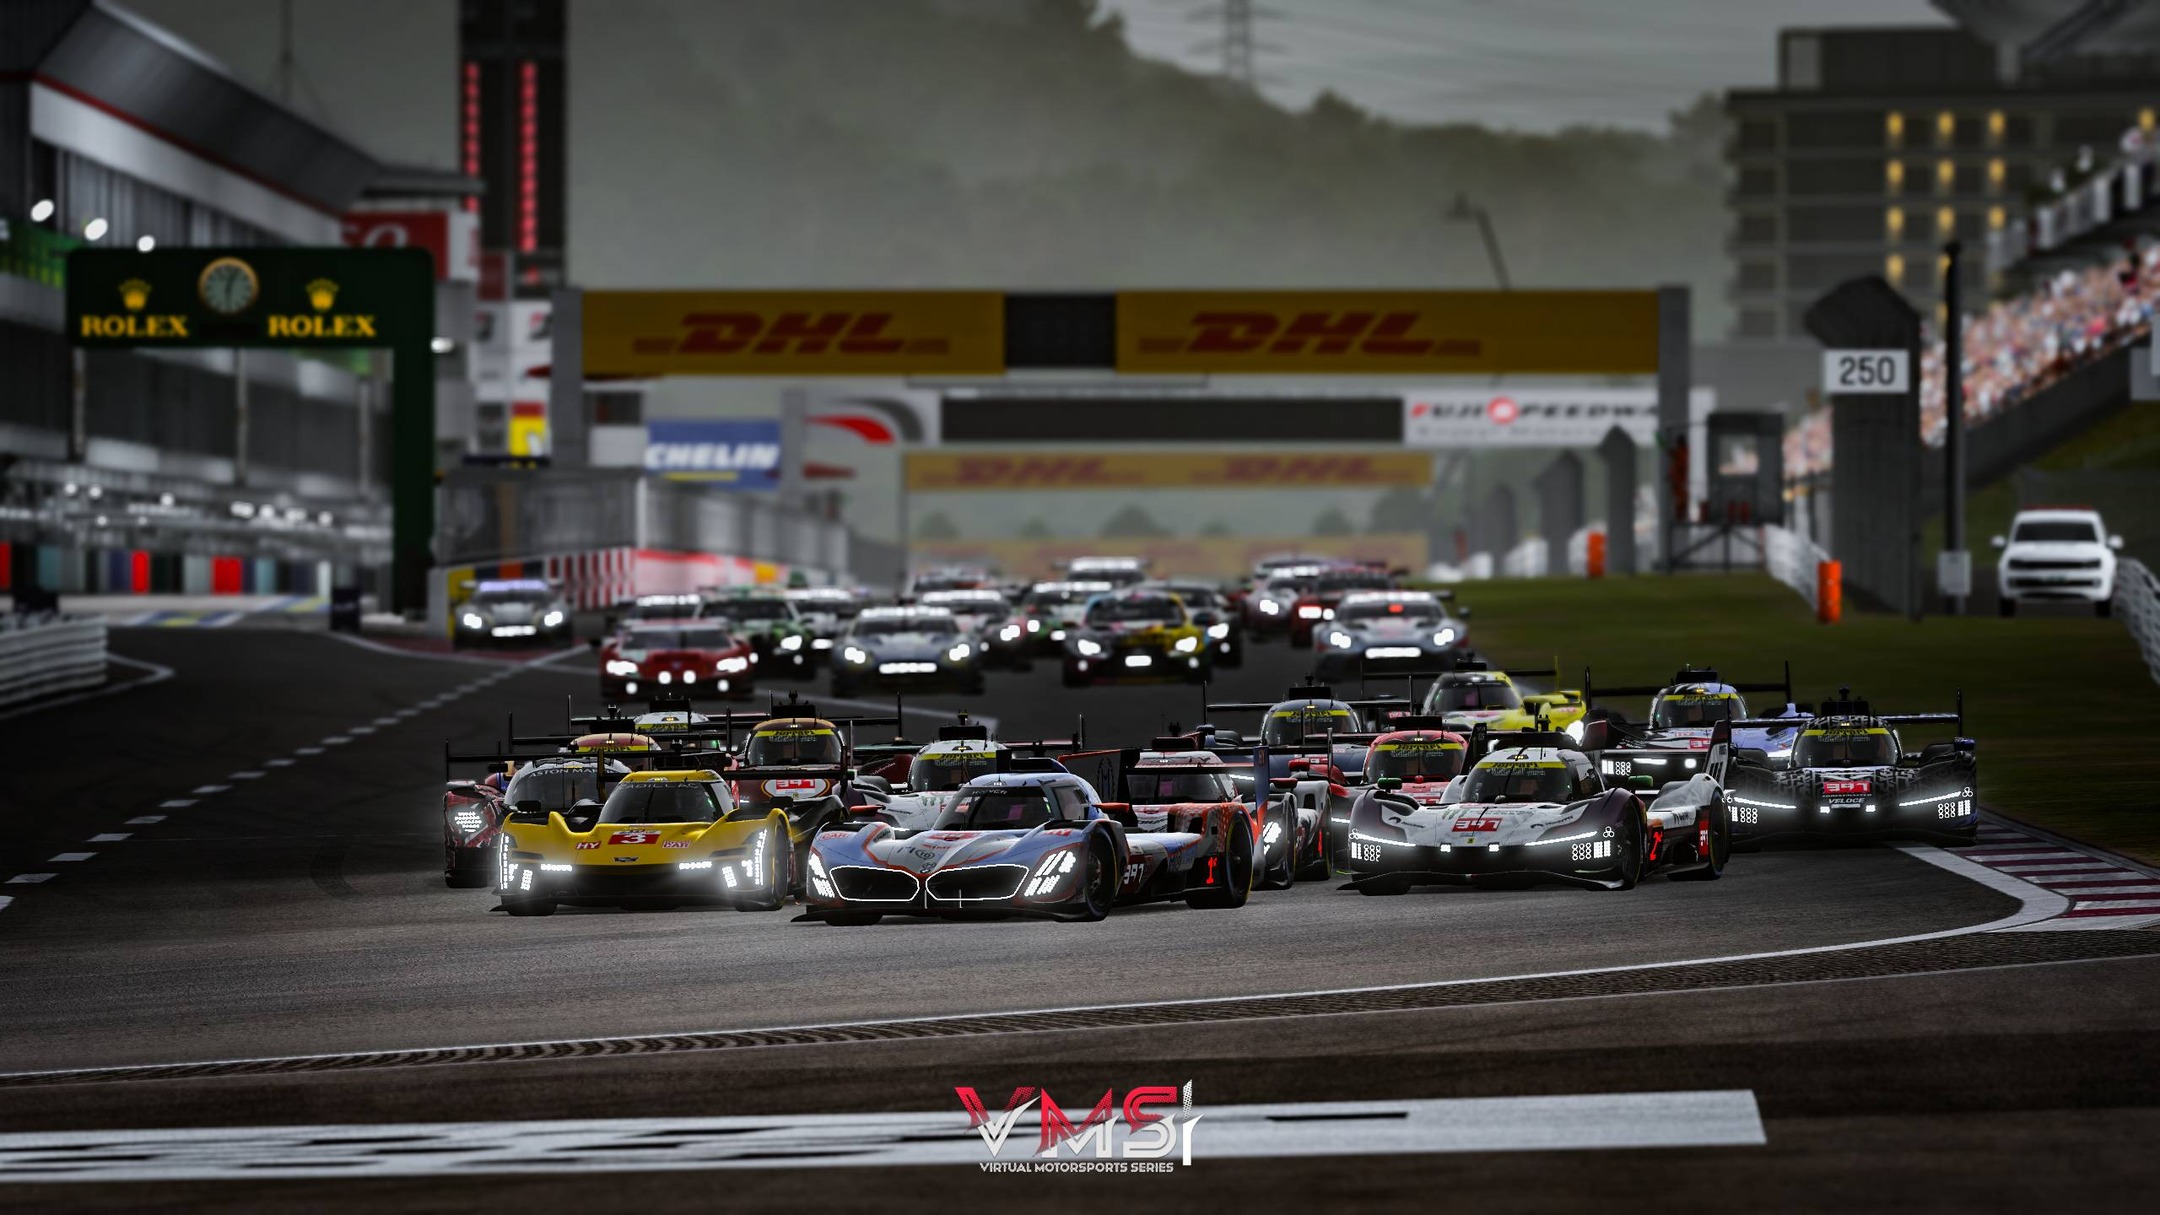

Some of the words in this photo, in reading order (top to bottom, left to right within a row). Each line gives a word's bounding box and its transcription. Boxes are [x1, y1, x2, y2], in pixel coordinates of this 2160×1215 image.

[81, 316, 189, 337] ROLEX
[268, 316, 376, 337] ROLEX
[680, 313, 901, 353] DHL
[1187, 312, 1434, 354] DHL
[1839, 357, 1895, 386] 250
[529, 769, 568, 779] ASTON
[577, 841, 599, 850] HY
[620, 832, 646, 844] 3
